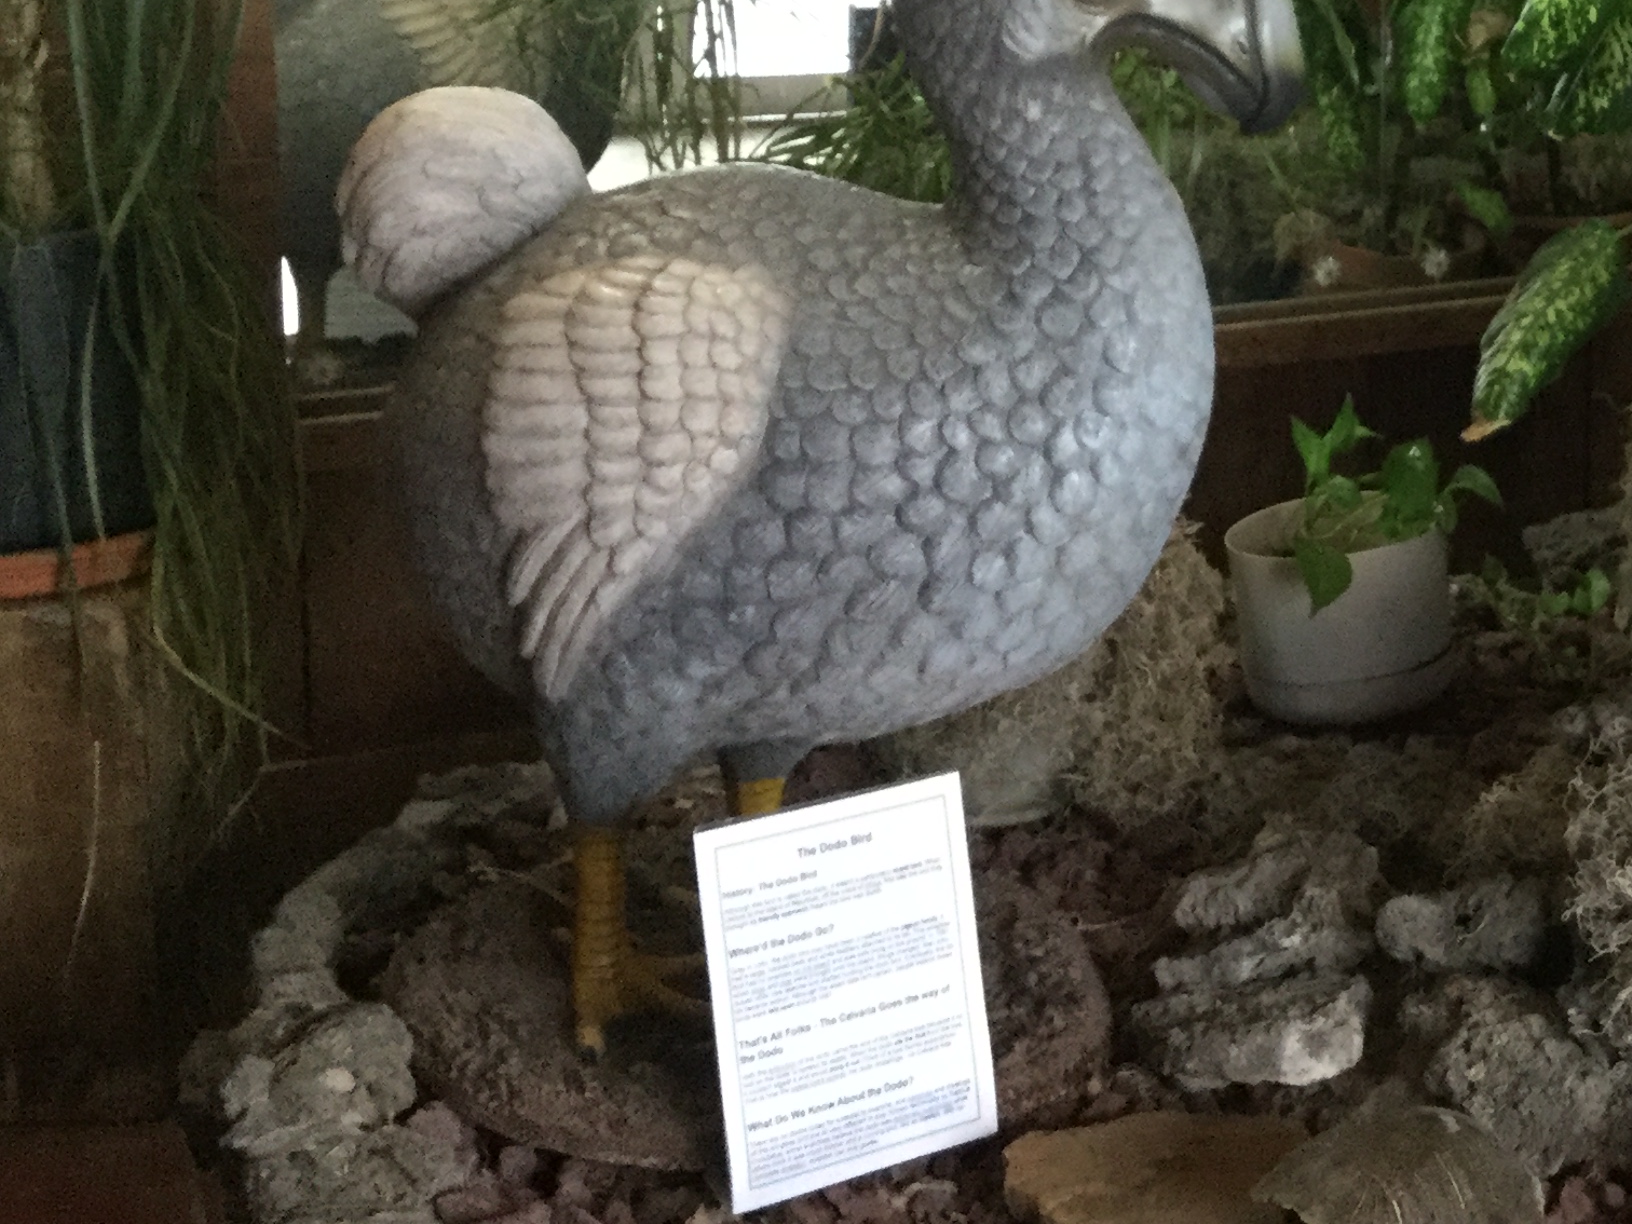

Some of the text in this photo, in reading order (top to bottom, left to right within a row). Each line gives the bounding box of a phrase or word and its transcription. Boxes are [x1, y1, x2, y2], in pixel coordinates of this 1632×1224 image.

[797, 832, 872, 858] The Dodo Bird
[787, 931, 812, 944] Dodo
